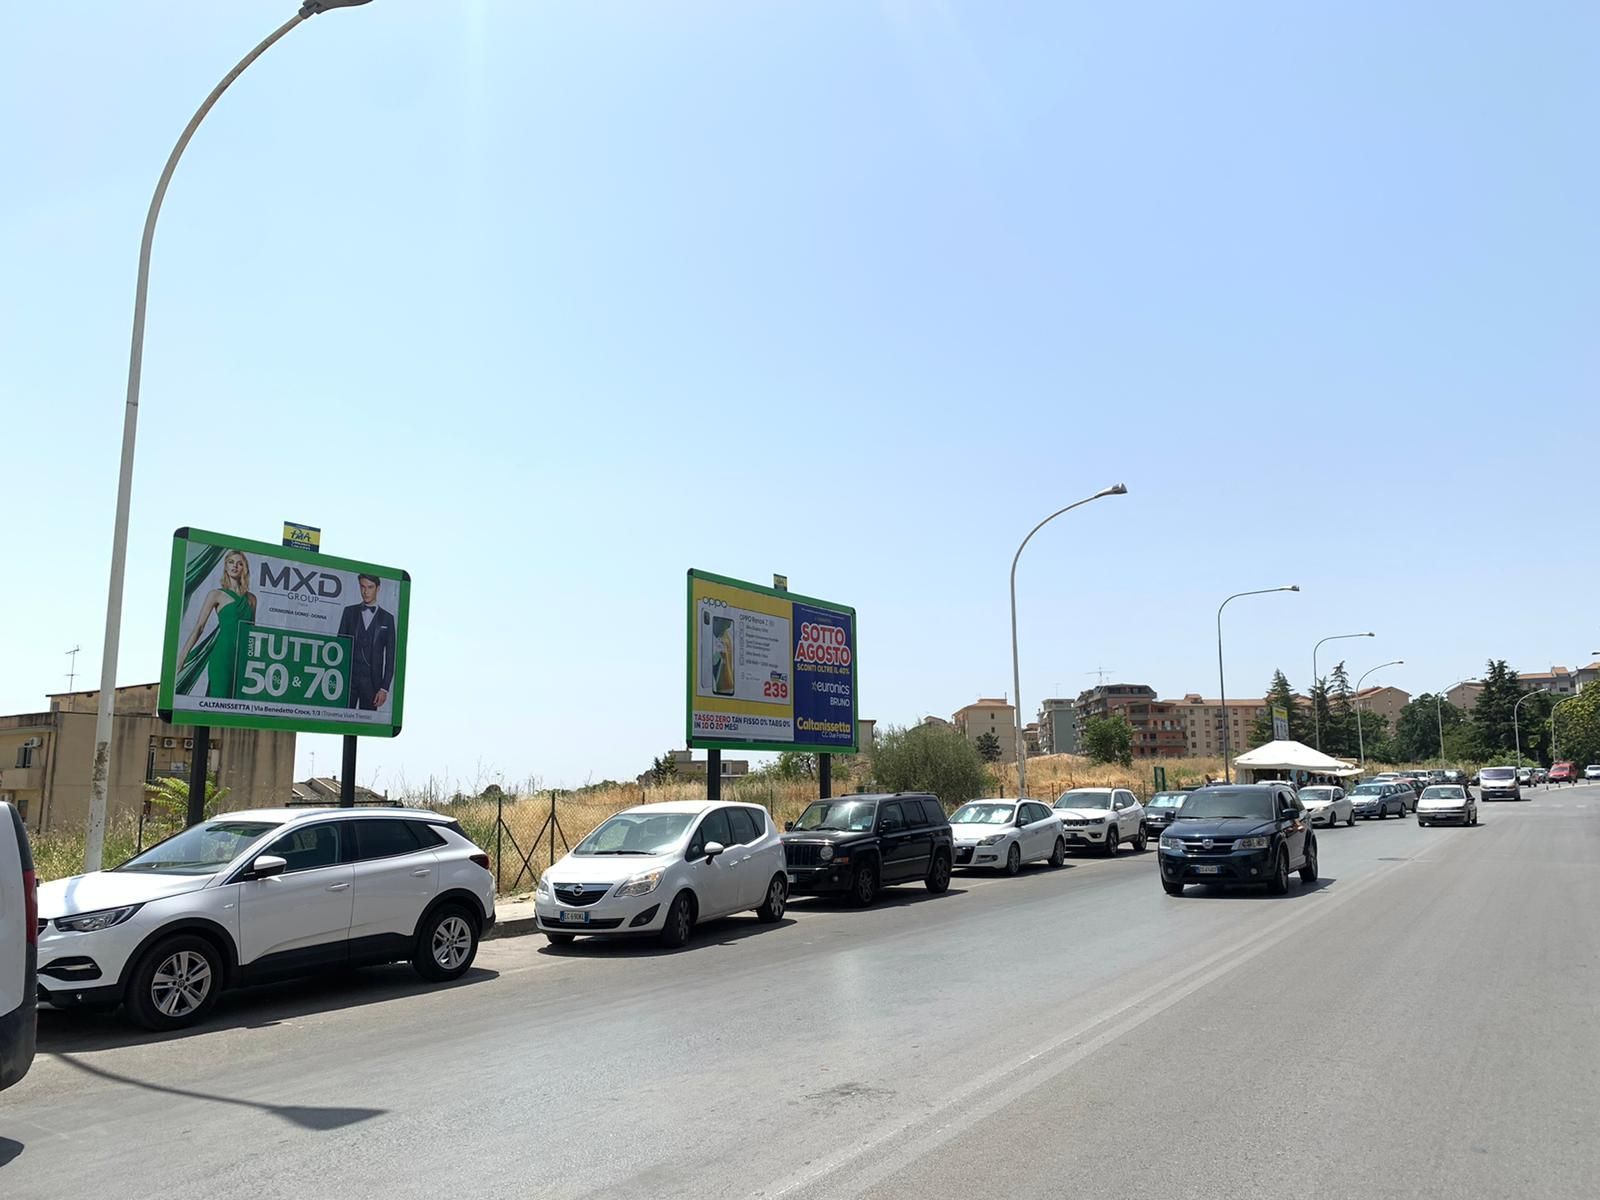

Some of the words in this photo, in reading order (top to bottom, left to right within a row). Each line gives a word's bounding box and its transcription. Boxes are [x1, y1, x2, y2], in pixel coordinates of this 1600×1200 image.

[260, 562, 342, 598] MXD
[287, 592, 320, 603] GROUP
[801, 623, 845, 646] SOTTO
[249, 631, 344, 667] TUTTO
[795, 641, 851, 666] AGOSTO
[292, 676, 302, 687] &
[816, 681, 850, 695] euronics
[763, 681, 788, 698] 239
[199, 701, 251, 711] CALTANISSETTA
[264, 705, 294, 715] Benedetto
[830, 697, 850, 707] BRUNO
[694, 713, 715, 722] TASSO
[715, 715, 731, 724] ZERO
[731, 716, 743, 724] TAN
[743, 717, 760, 726] FISSO
[694, 721, 701, 729] IN
[724, 723, 739, 731] MESI
[797, 716, 851, 733] Caltanissetta
